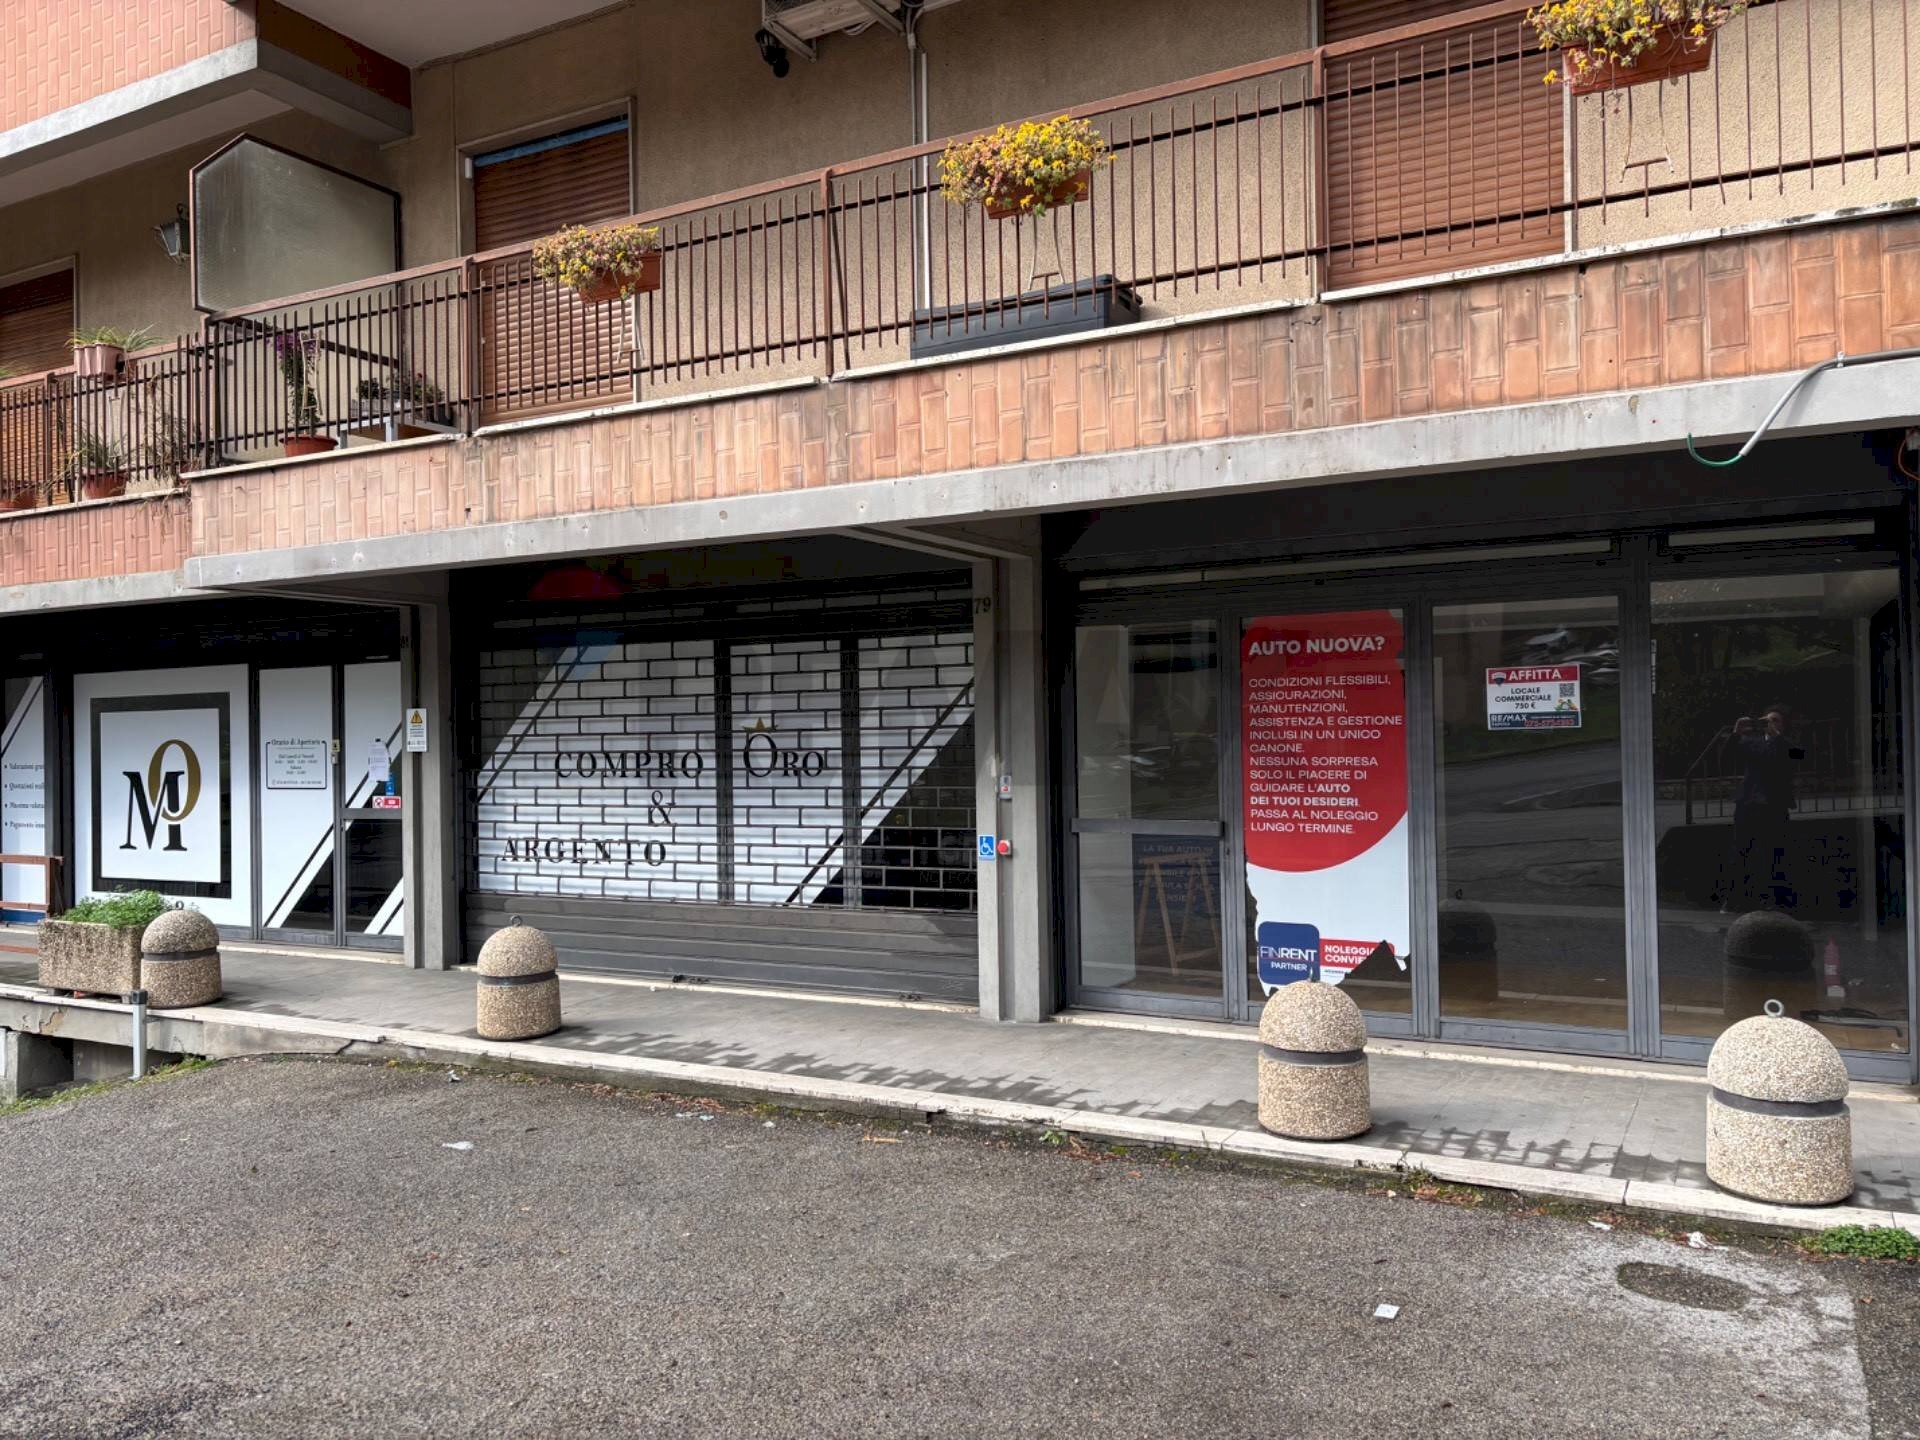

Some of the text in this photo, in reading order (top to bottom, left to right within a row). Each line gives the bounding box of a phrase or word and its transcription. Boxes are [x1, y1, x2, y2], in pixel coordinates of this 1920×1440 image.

[975, 597, 991, 614] 79
[1249, 636, 1385, 656] AUTO NUOVA?
[1509, 668, 1562, 681] AFFITTA
[1248, 674, 1391, 688] CONDIZIONI FLESSIBILI,
[1248, 689, 1347, 701] ASSICURAZIONI,
[1495, 694, 1552, 702] COMMERCIALE
[1249, 702, 1348, 714] MANUTENZIONI,
[1249, 715, 1403, 727] ASSISTENZA E GESTIONE
[1490, 714, 1527, 722] RE/MAX
[1249, 729, 1381, 740] INCLUSI IN UN UNICO
[554, 751, 703, 779] COMPRO
[1249, 756, 1308, 766] NESSUNA
[1249, 769, 1367, 780] SOLO IL PIACERE DI
[1249, 783, 1351, 793] GUIDARE L'AUTO
[1250, 796, 1269, 805] DEI
[1271, 796, 1300, 806] TUOI
[648, 790, 677, 827] &
[1250, 809, 1379, 821] PASSA AL NOLEGGIO
[1250, 822, 1295, 832] LUNGO
[501, 837, 667, 867] ARGENTO
[1260, 945, 1317, 962] FINRENT
[1271, 961, 1308, 971] PARTNER
